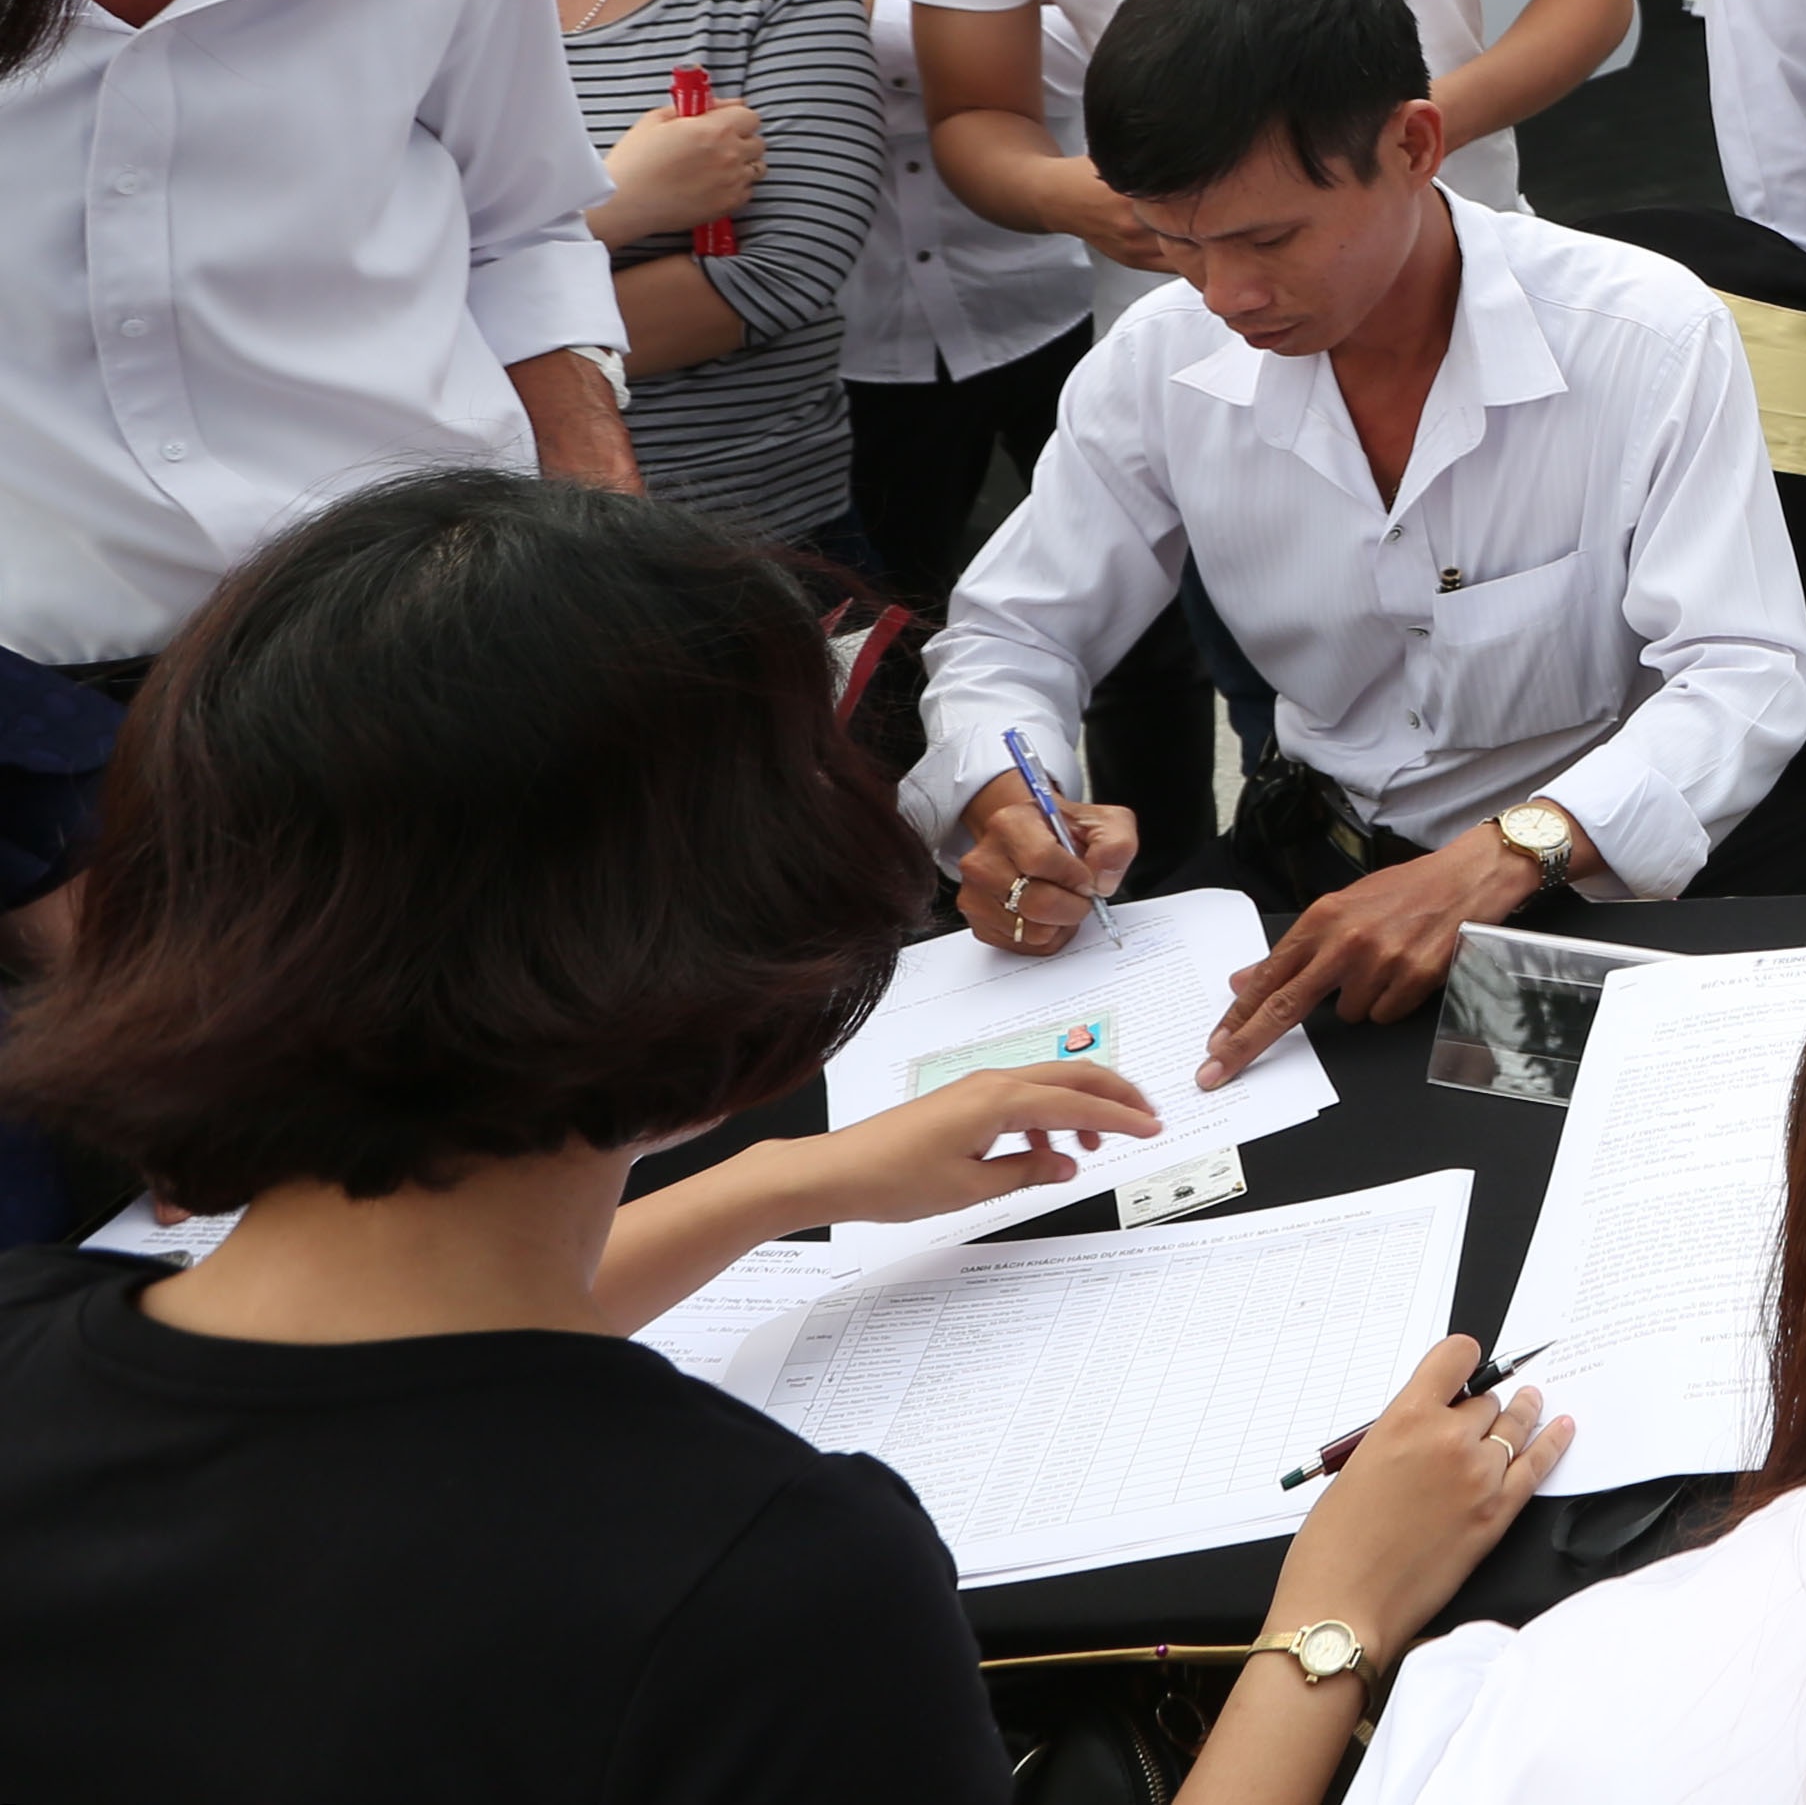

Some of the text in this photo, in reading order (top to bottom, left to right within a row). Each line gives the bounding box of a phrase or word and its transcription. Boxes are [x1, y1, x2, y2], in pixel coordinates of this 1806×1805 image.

[750, 1249, 805, 1258] NGUYÊN
[1026, 1256, 1066, 1268] KHÁCH
[1066, 1251, 1100, 1265] HÀNG
